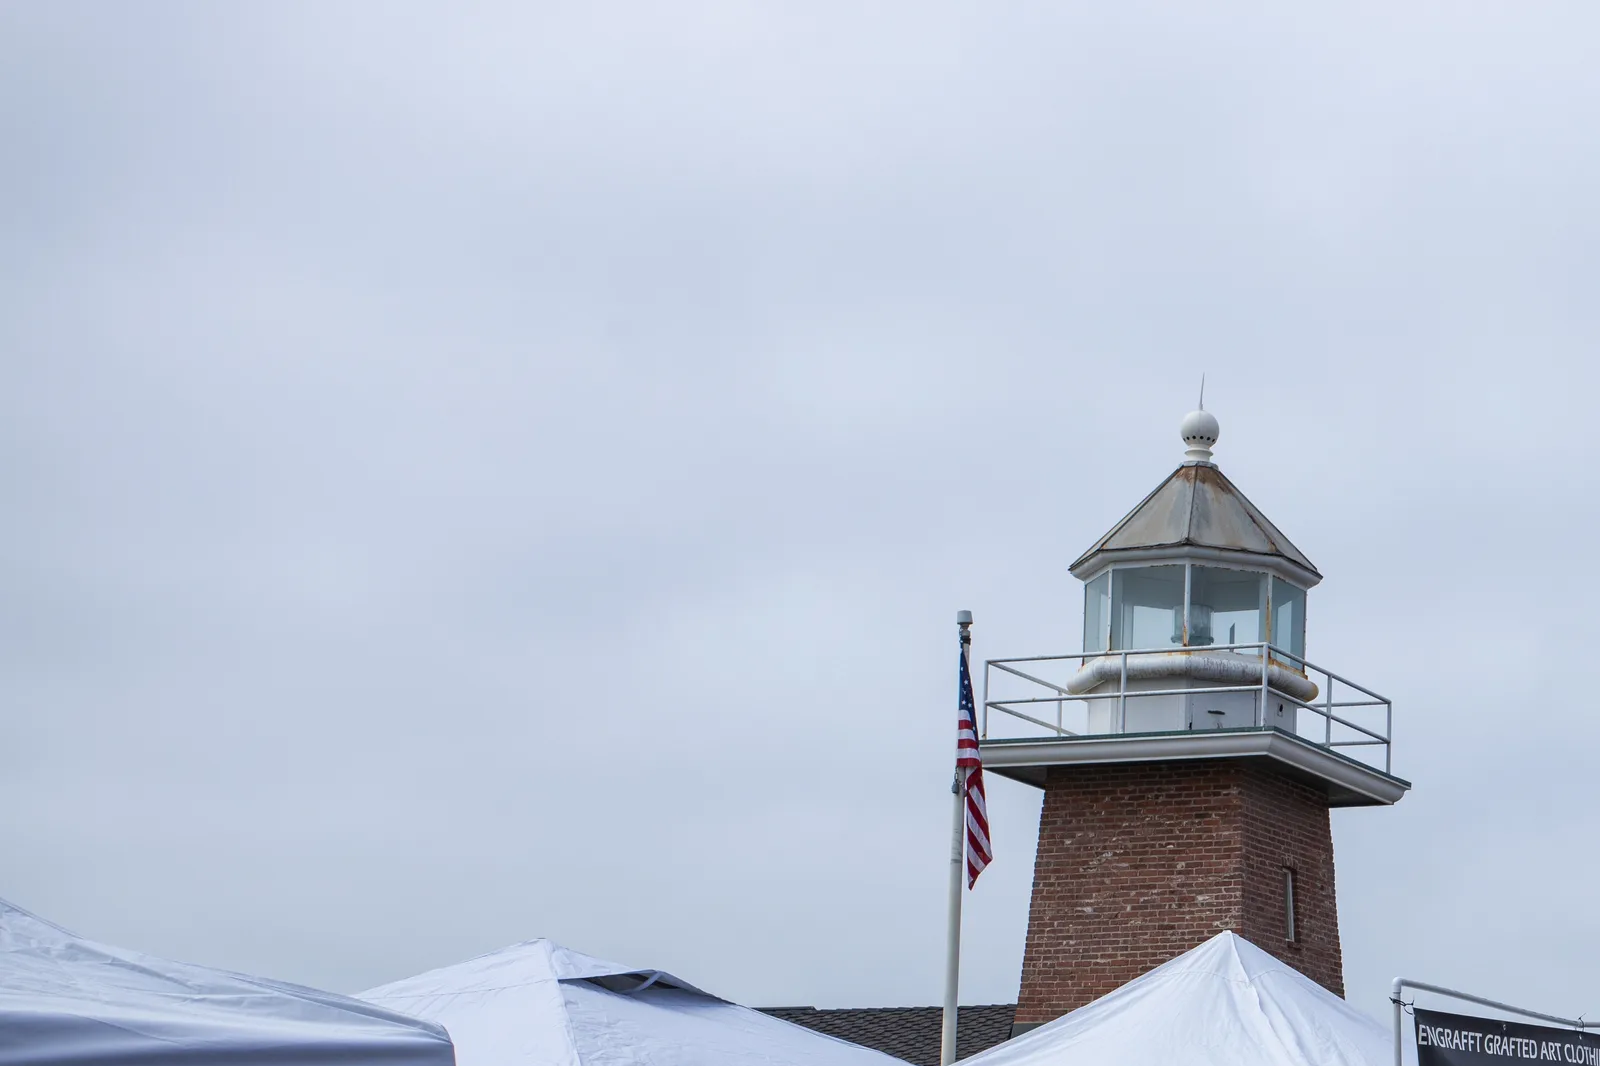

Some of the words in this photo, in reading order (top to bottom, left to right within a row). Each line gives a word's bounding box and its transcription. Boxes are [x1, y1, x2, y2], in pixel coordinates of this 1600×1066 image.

[1418, 1025, 1482, 1052] ENGRAFFT
[1484, 1034, 1538, 1059] GRAFTED
[1540, 1041, 1562, 1061] ART
